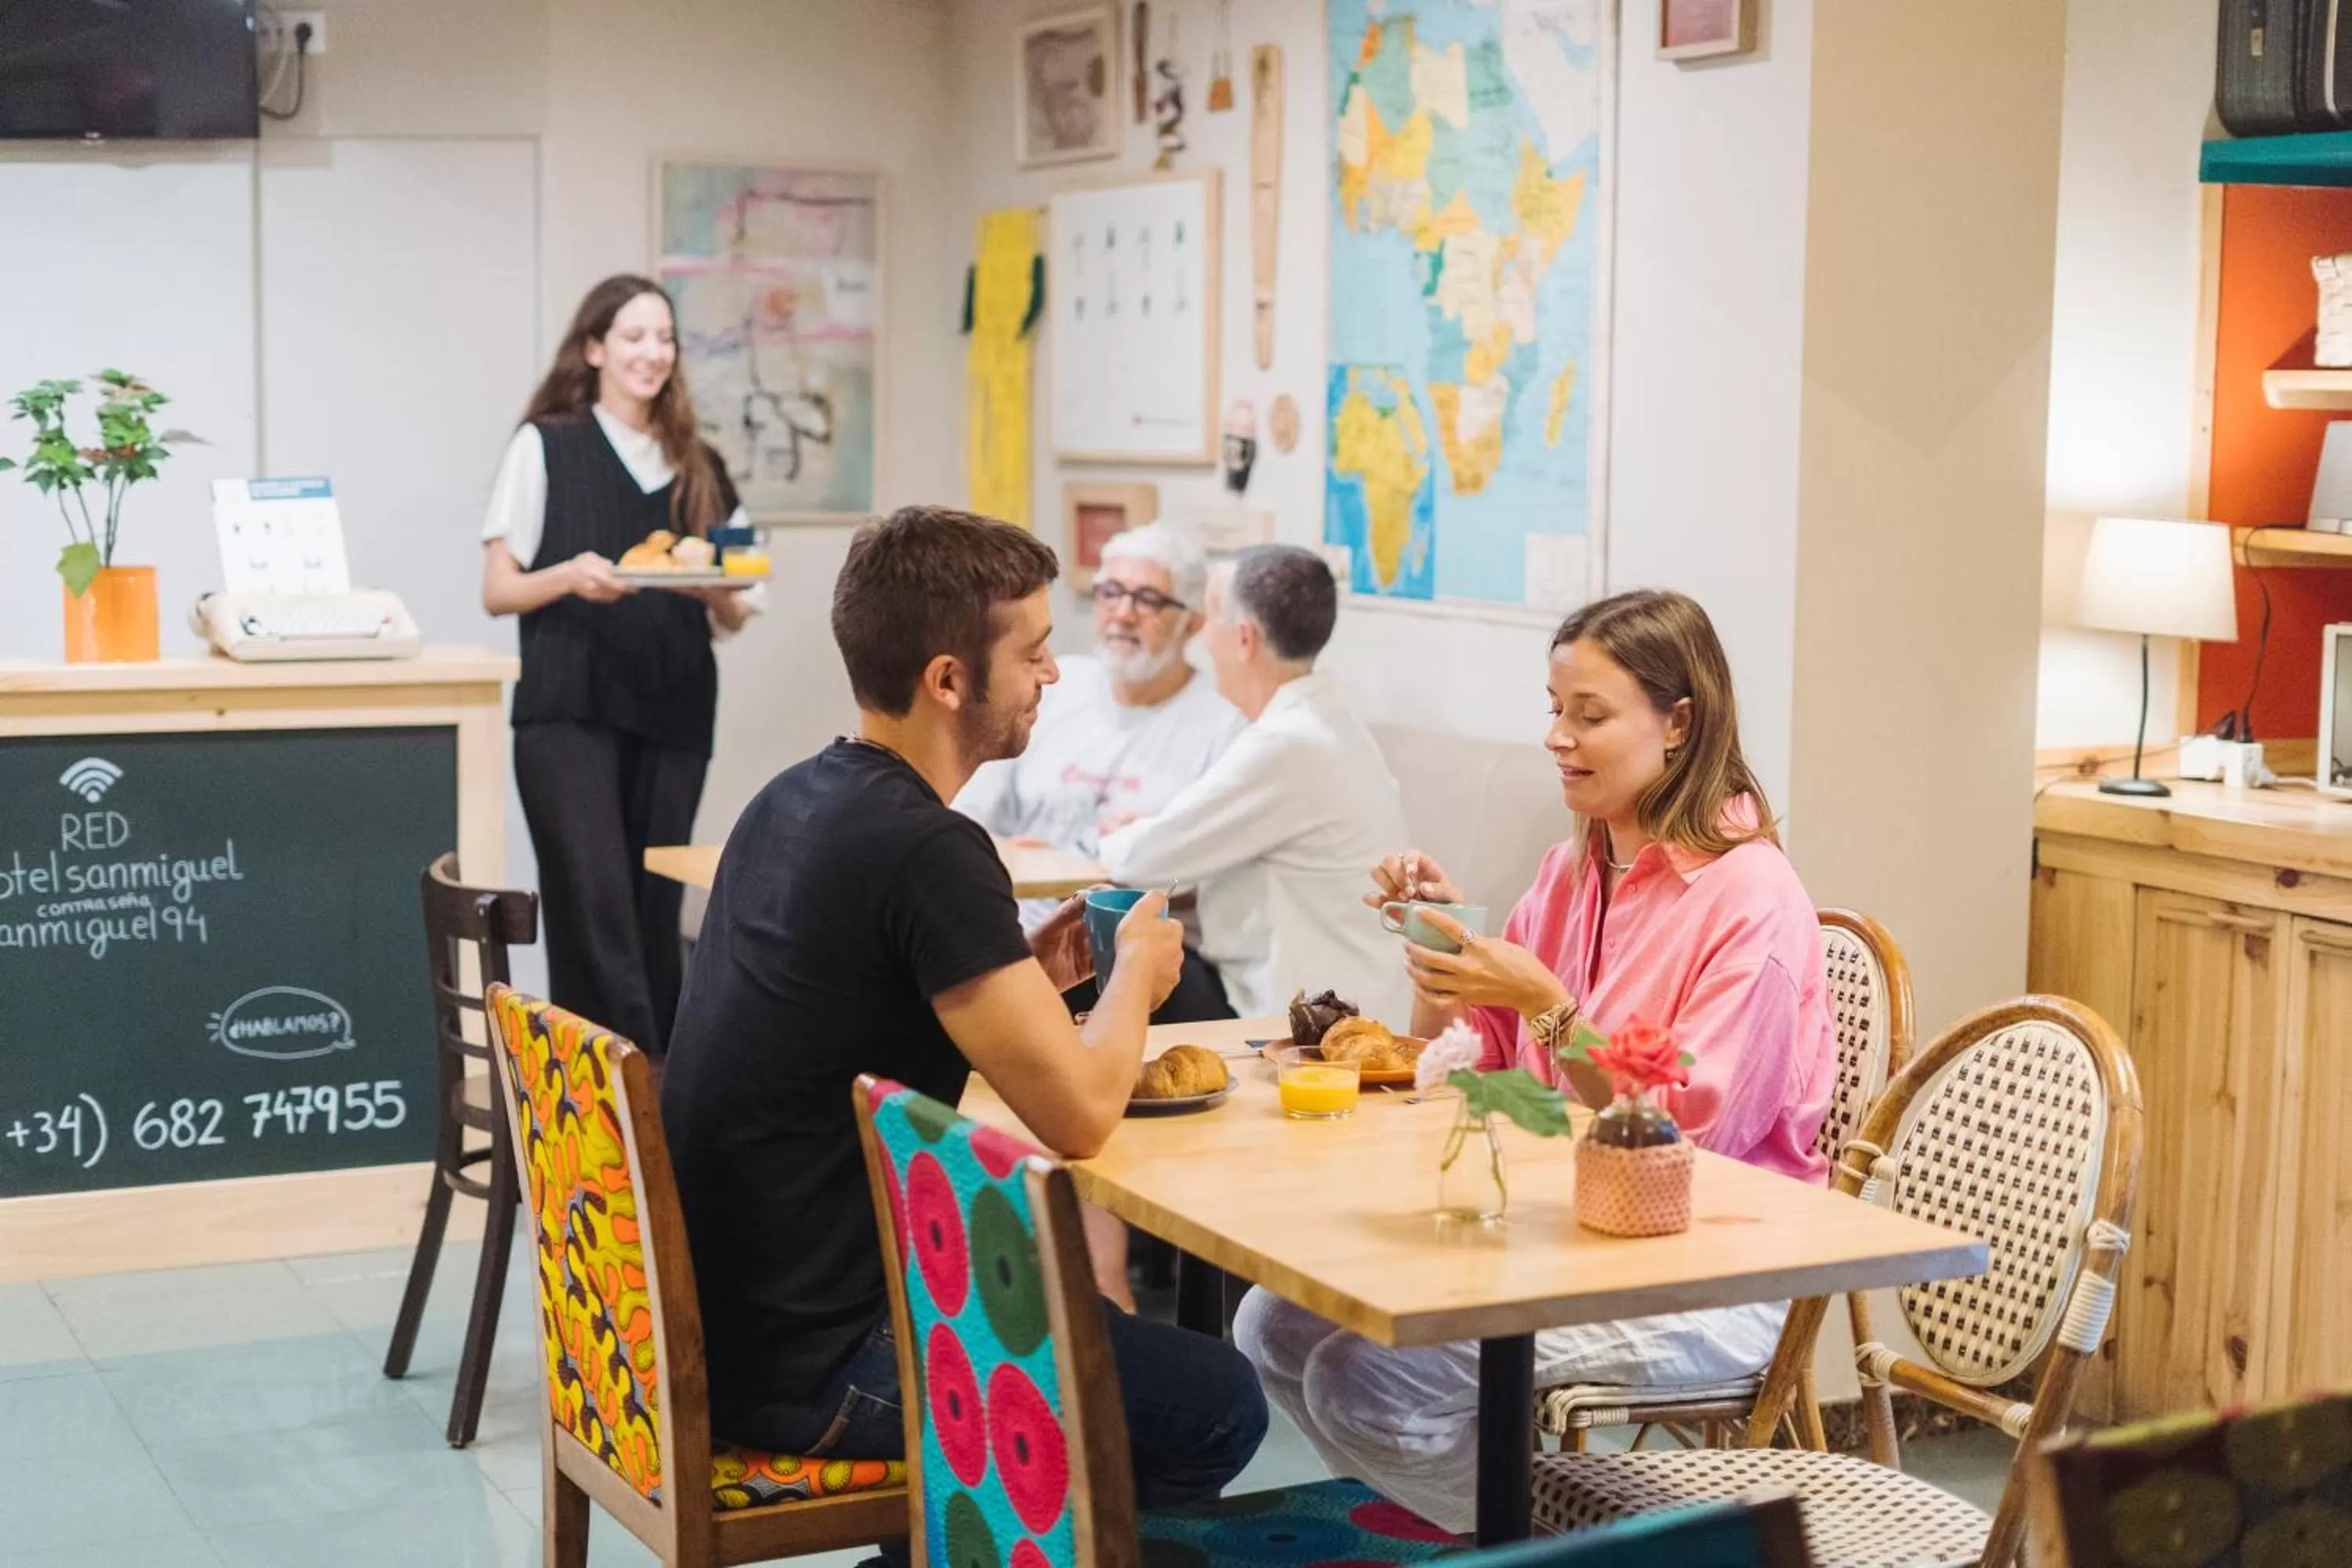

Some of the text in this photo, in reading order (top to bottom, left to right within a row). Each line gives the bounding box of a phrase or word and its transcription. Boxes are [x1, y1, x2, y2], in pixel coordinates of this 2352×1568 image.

[61, 811, 129, 851] RED
[5, 1080, 407, 1169] +34) 682 747955
